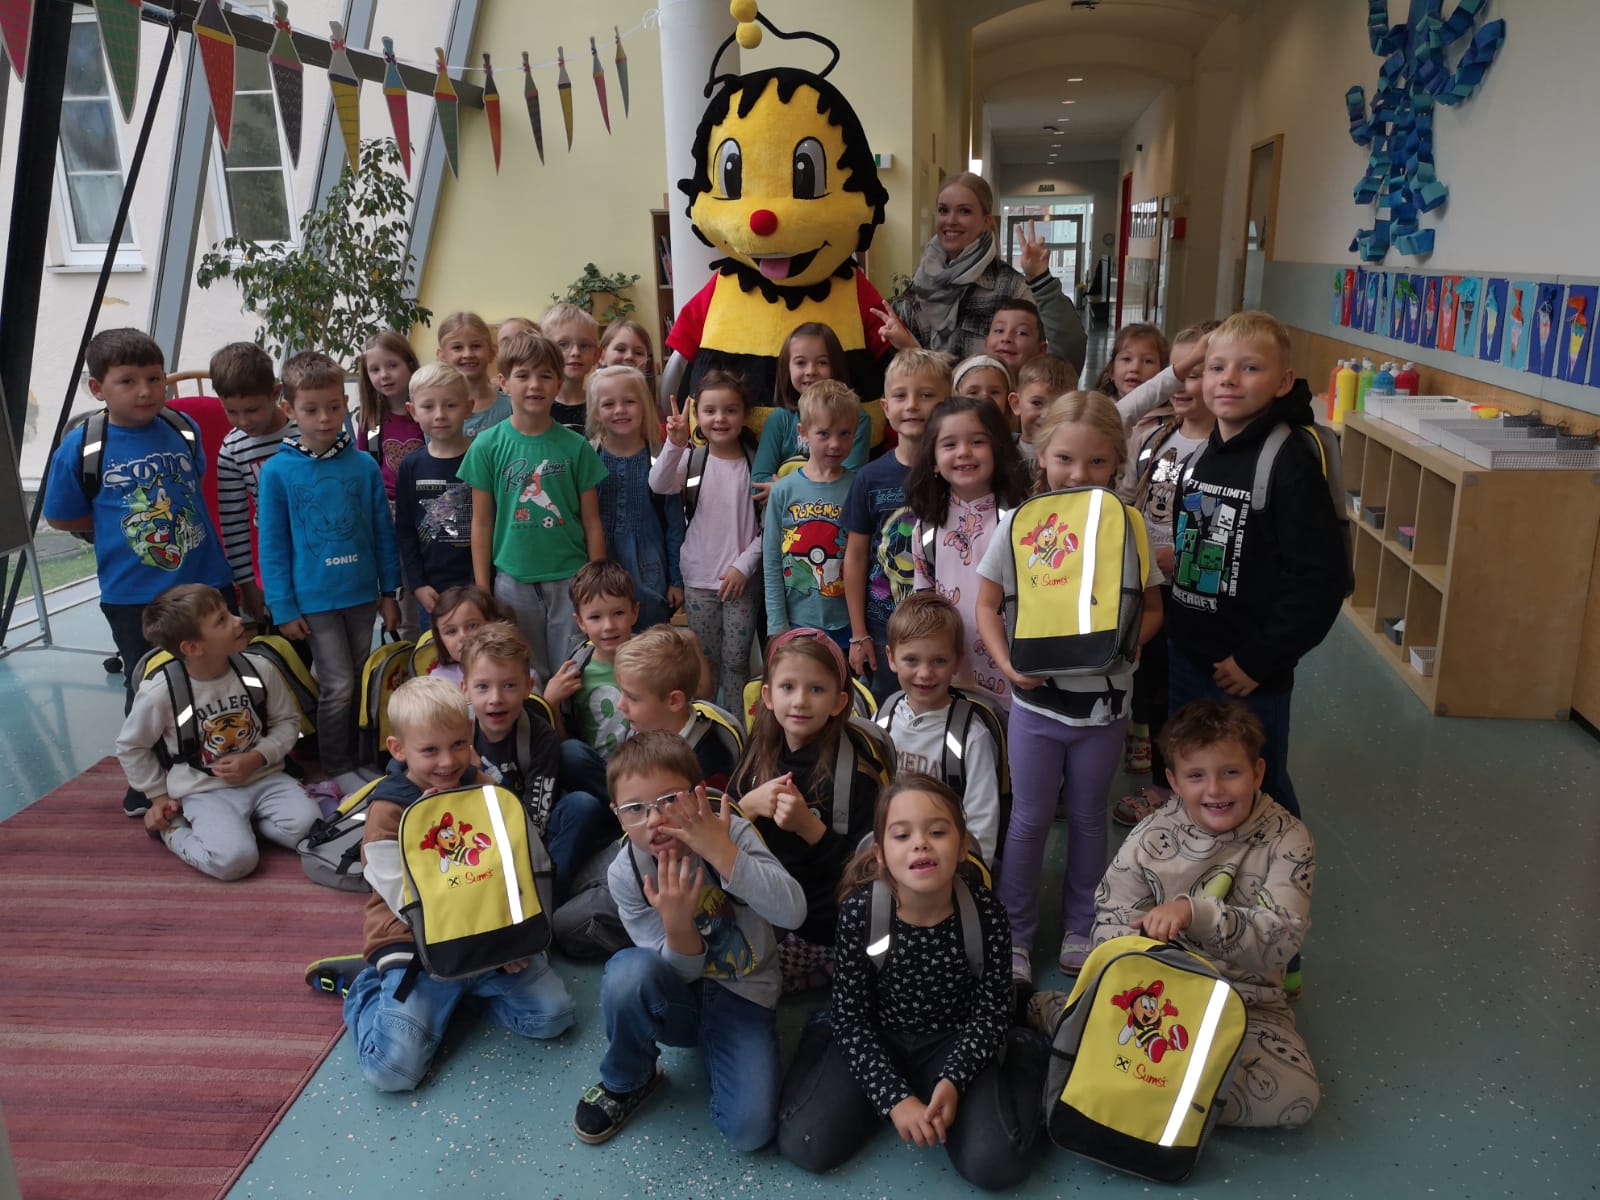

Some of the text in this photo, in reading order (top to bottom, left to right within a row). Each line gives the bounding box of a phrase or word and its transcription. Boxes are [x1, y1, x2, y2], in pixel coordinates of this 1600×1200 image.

[1222, 486, 1251, 501] LIMITS
[1232, 529, 1245, 560] CREATE,
[325, 553, 359, 567] SONIC
[196, 694, 250, 720] OLLEG
[1133, 1063, 1169, 1088] Sumsi
